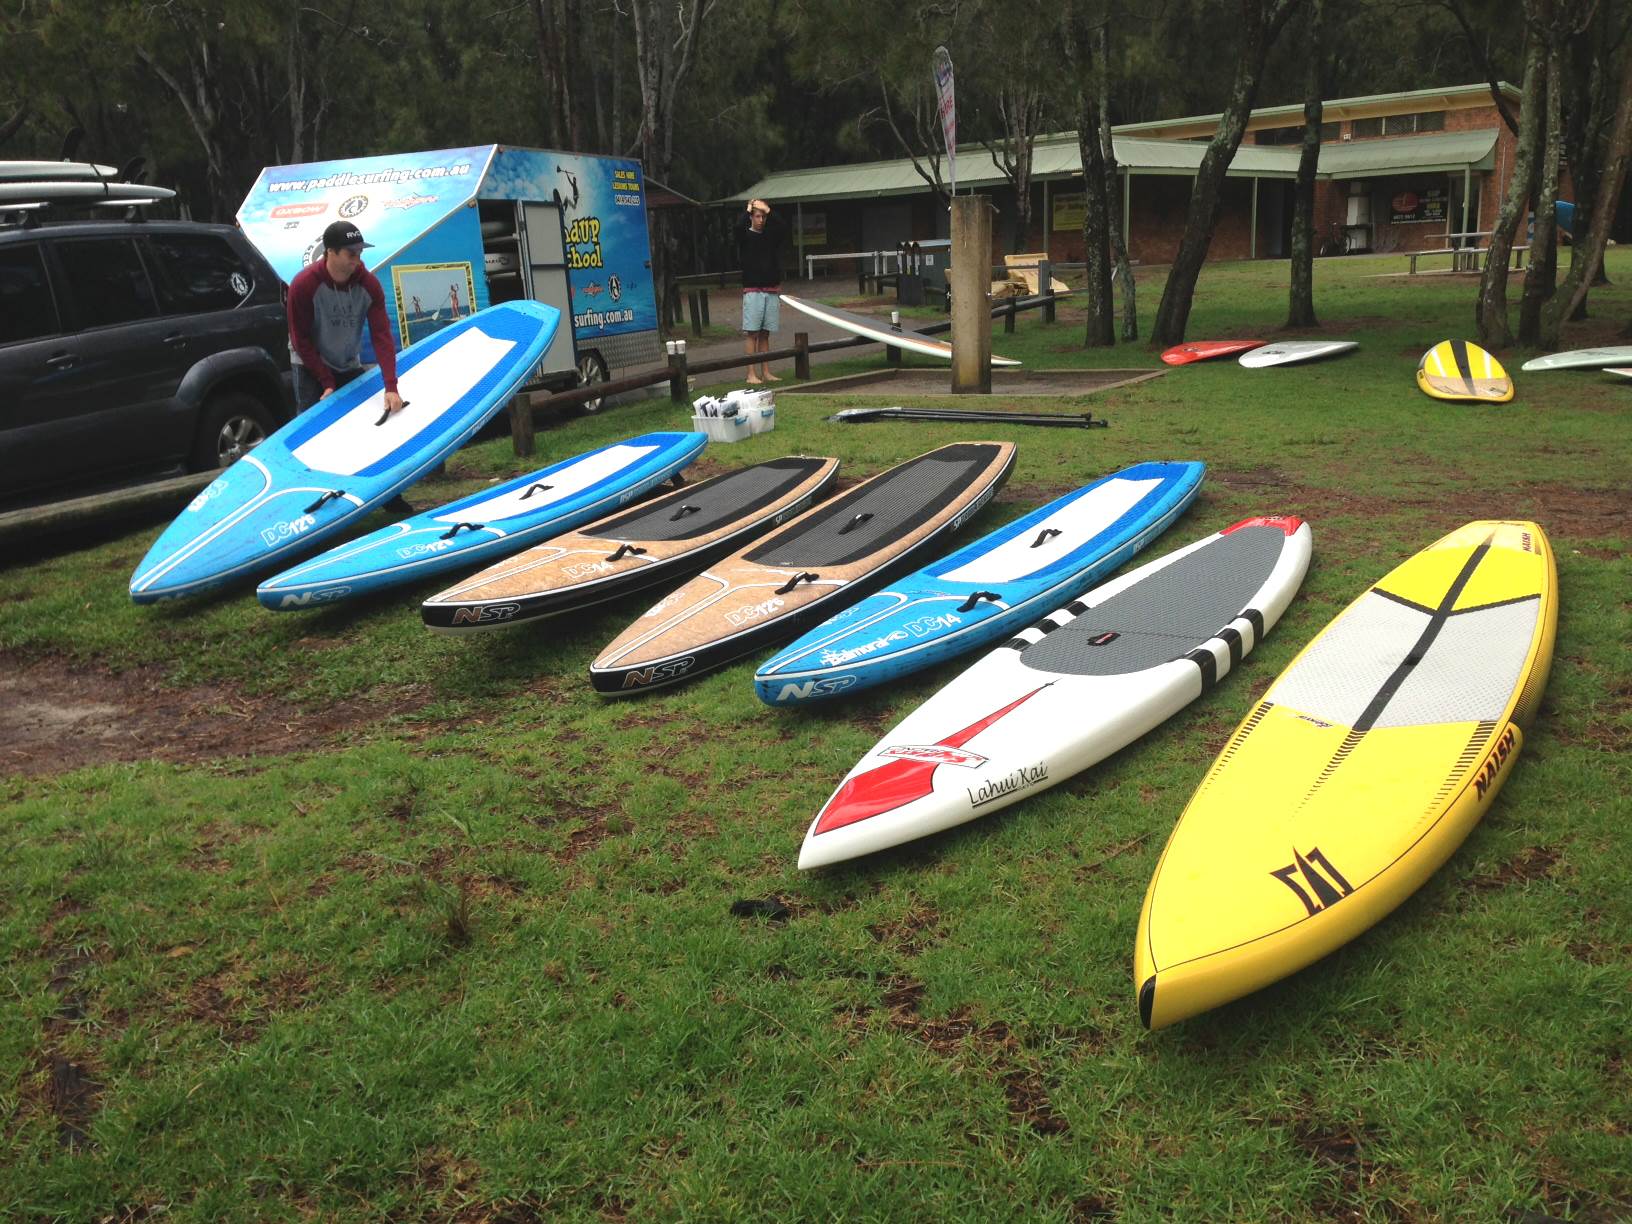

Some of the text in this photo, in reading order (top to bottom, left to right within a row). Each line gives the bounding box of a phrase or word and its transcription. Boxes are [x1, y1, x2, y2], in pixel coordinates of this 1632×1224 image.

[268, 164, 470, 192] www.paddlesurfing.com.au
[574, 309, 633, 329] surfing.com.au
[452, 603, 521, 624] NSP
[903, 613, 961, 638] DC14
[622, 656, 696, 688] NSP
[776, 675, 857, 701] NSP
[1473, 728, 1516, 801] NAISH
[967, 761, 1048, 805] Lahui Kai
